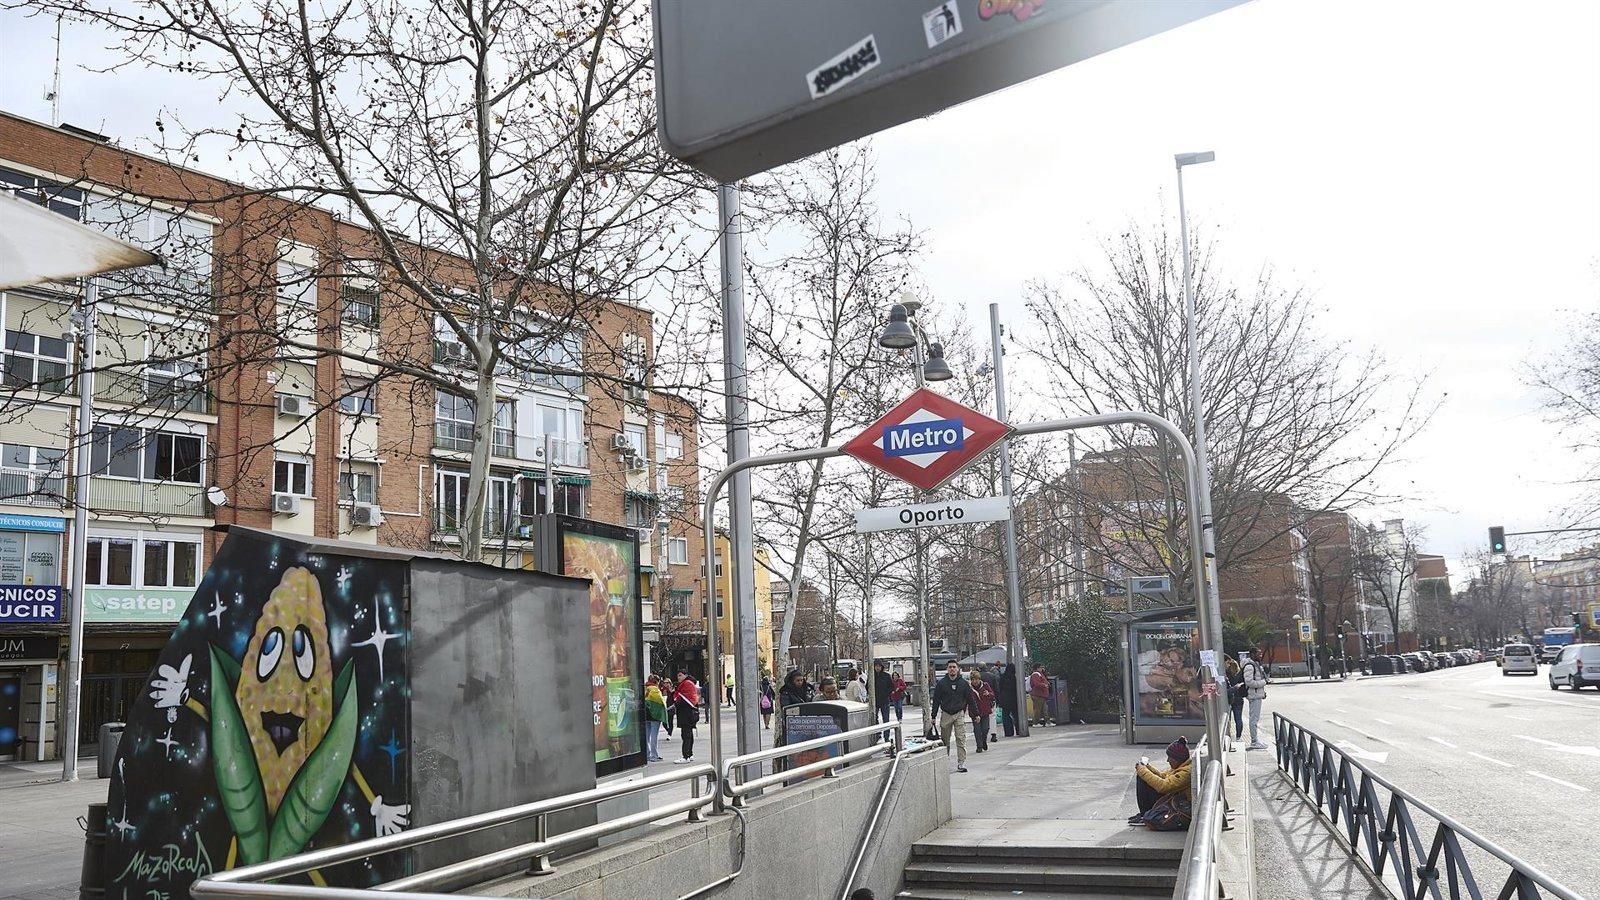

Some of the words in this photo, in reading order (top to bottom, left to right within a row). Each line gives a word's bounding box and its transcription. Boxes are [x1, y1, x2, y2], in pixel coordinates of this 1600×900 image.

[890, 427, 957, 450] Metro
[31, 519, 63, 529] CONDUCIR
[899, 506, 964, 525] Oporto
[106, 593, 176, 613] satep
